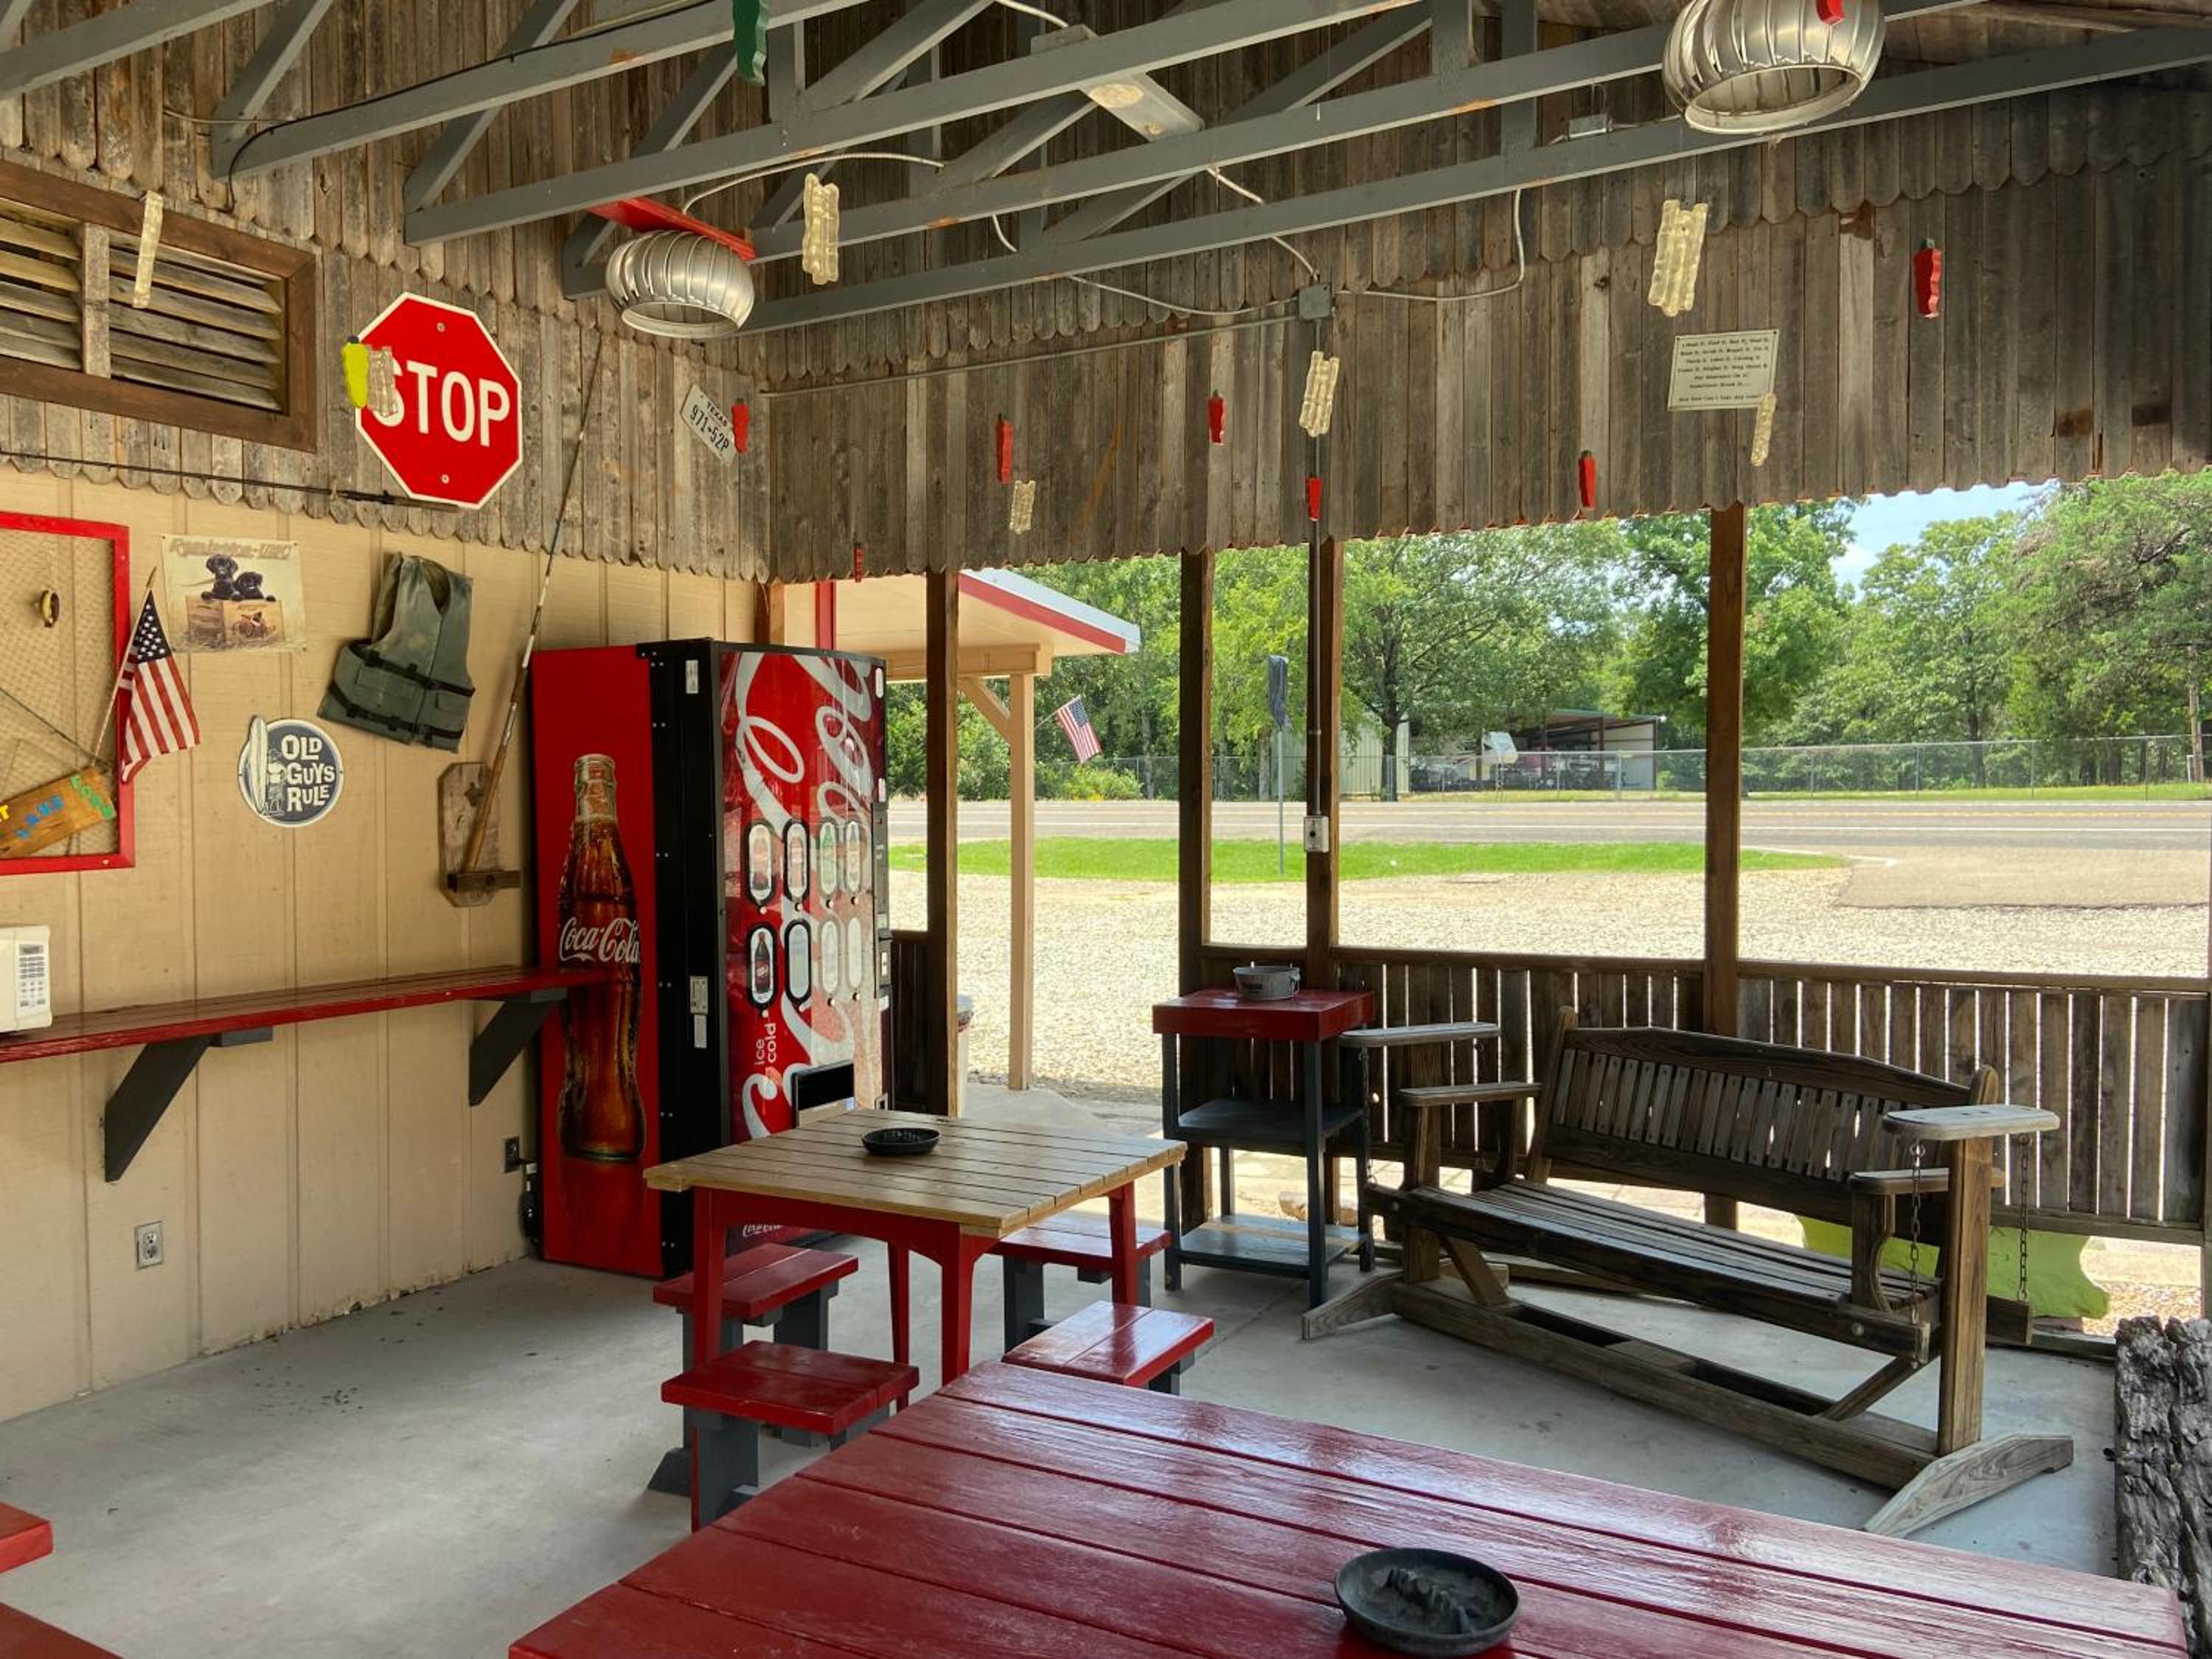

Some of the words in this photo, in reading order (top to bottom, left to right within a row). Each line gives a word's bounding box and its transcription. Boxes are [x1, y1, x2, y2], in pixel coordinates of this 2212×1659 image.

[707, 401, 728, 426] TEXAS
[281, 734, 322, 760] OLD
[286, 762, 335, 785] GUYS
[287, 785, 330, 812] RULE
[560, 917, 641, 964] Coca-Cola
[755, 1038, 765, 1065] ice
[765, 1022, 777, 1063] cold
